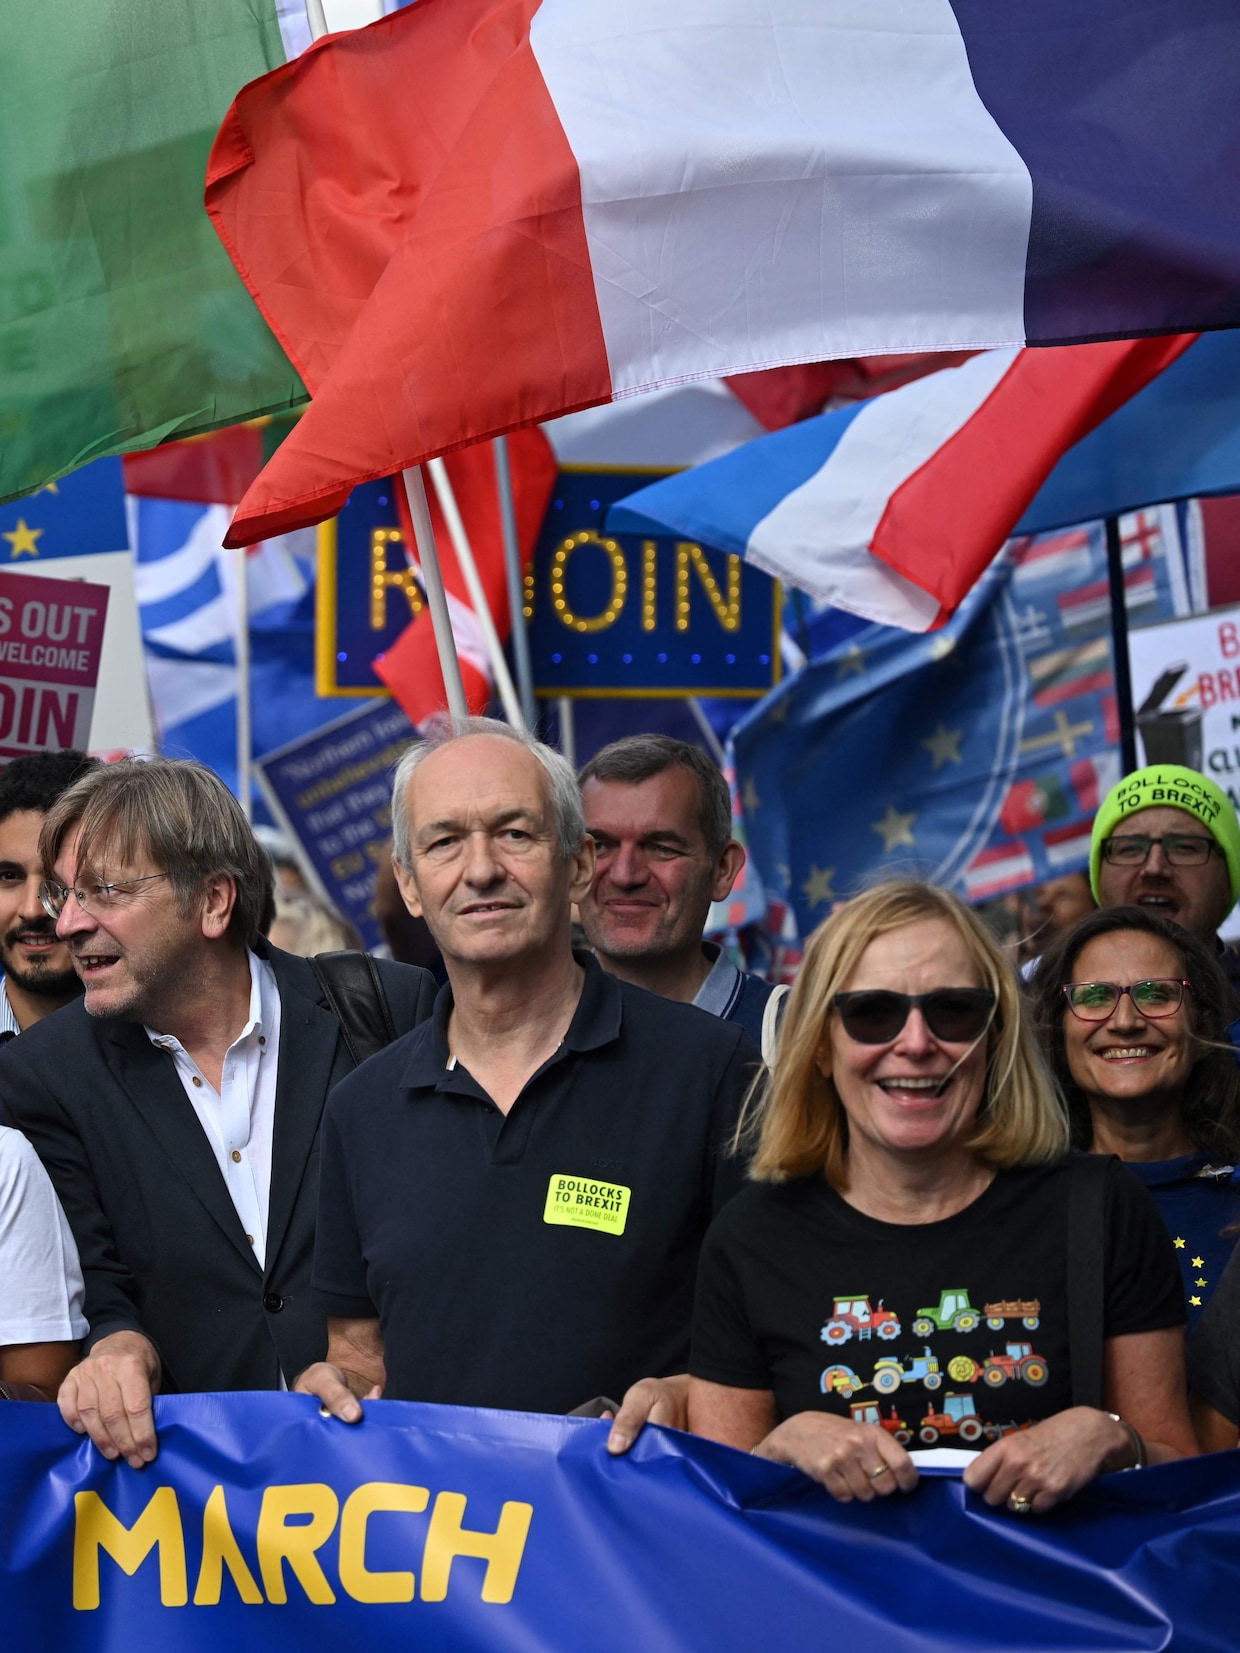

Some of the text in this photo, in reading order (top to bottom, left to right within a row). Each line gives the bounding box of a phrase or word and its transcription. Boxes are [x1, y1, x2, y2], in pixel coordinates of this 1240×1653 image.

[371, 526, 742, 633] ROIN
[21, 600, 97, 644] OUT
[1117, 774, 1222, 818] BOLLOCKS
[1118, 794, 1141, 813] TO
[1152, 788, 1217, 823] BREXIT
[555, 1191, 622, 1212] TO BREXIT
[558, 1179, 622, 1200] BOLLOCKS
[566, 1206, 578, 1215] NOT
[585, 1209, 602, 1219] DONE
[603, 1213, 618, 1223] DEAL
[73, 1482, 534, 1611] MARCH
